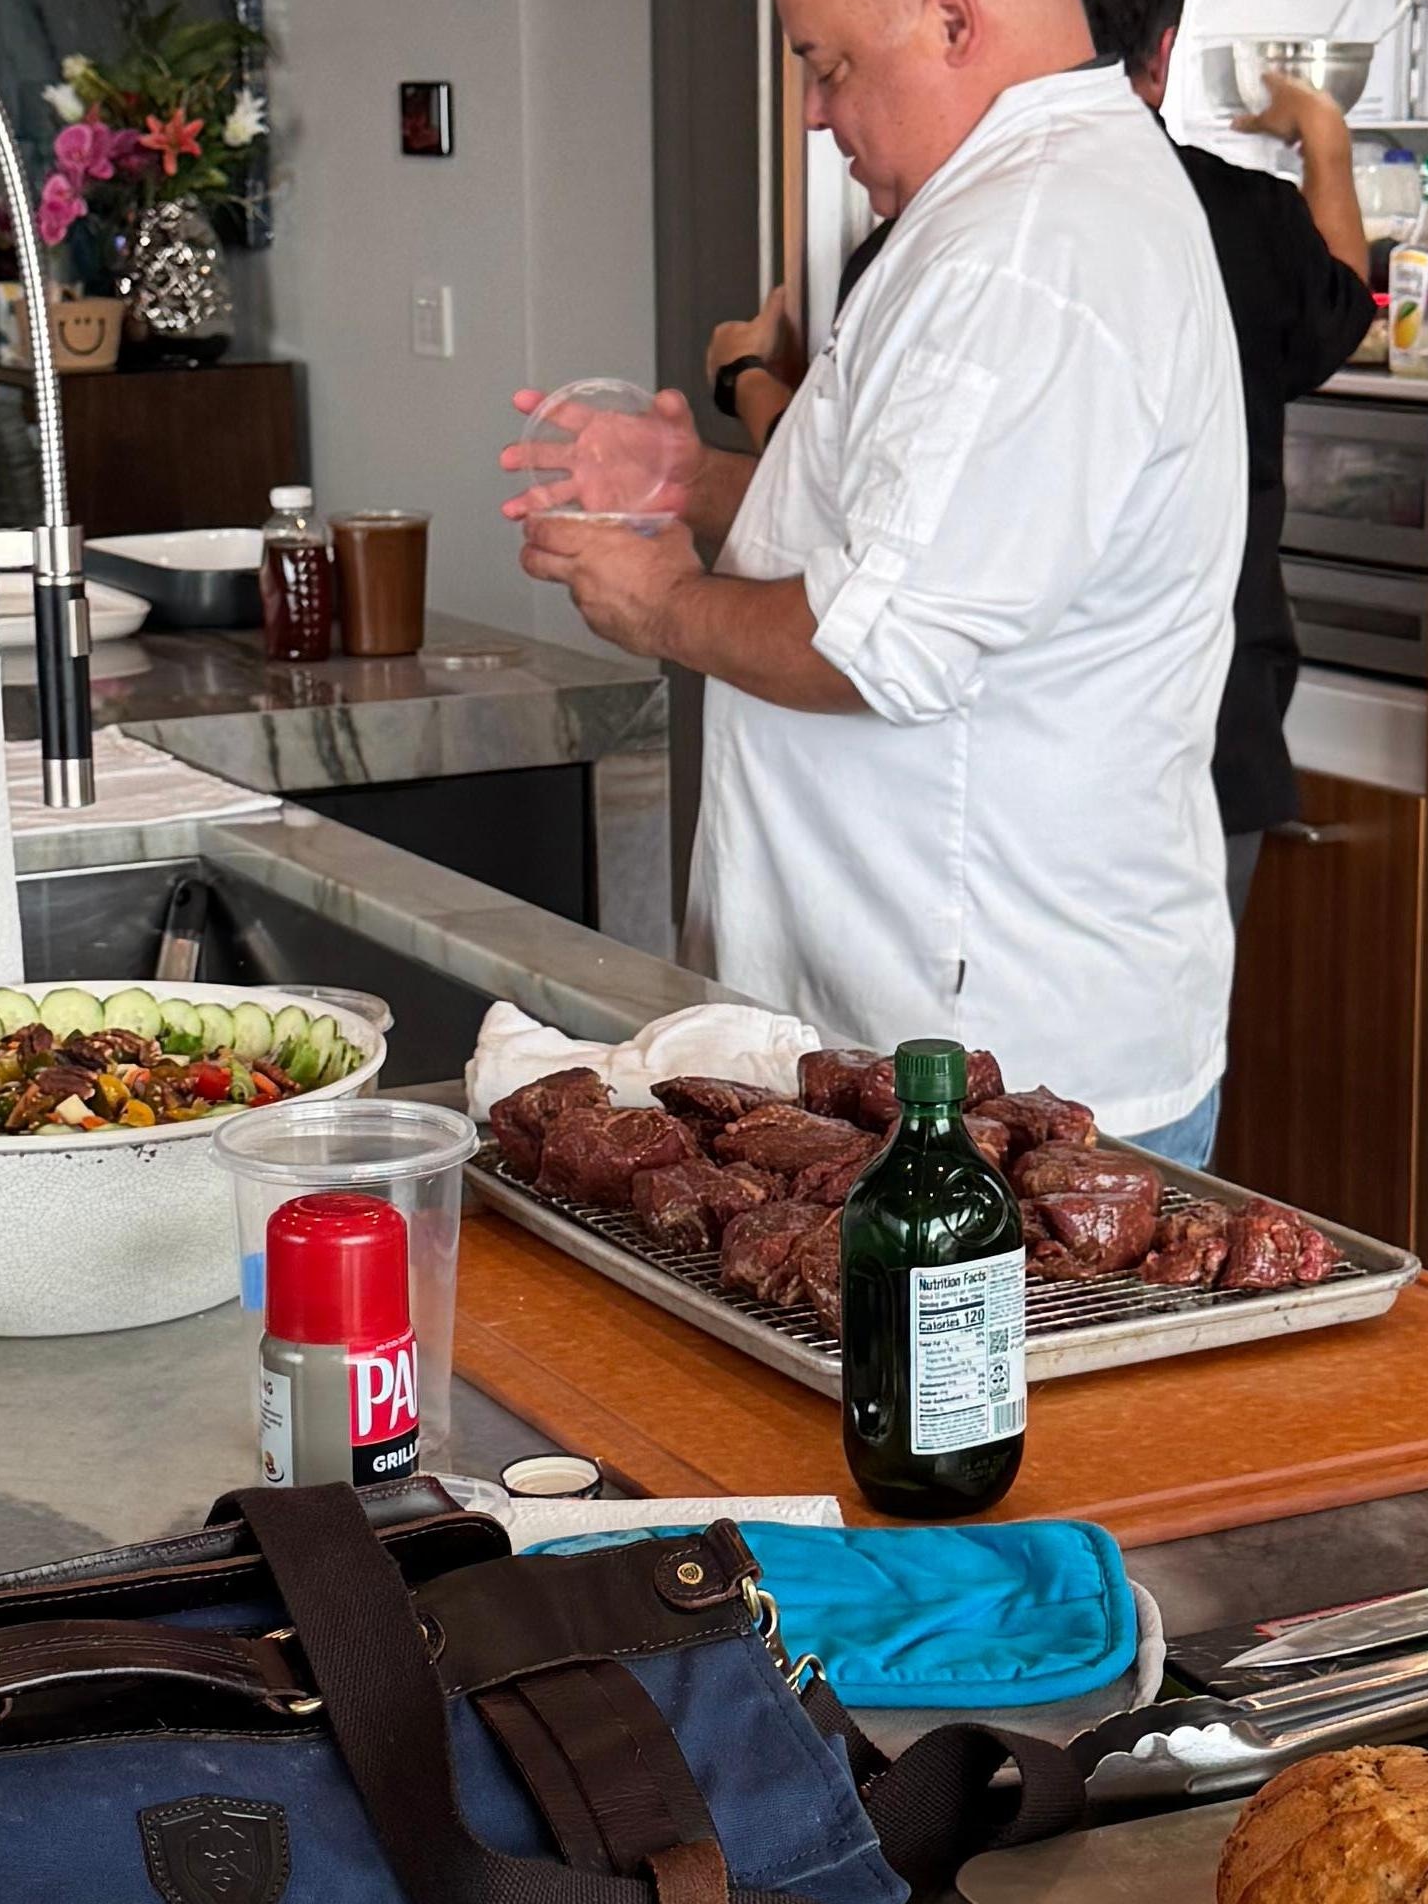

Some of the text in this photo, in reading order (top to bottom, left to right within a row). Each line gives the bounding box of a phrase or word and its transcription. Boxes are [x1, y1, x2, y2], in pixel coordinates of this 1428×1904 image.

[918, 1271, 987, 1291] Nutrition Facts
[918, 1318, 960, 1331] Calories
[964, 1307, 985, 1324] 120
